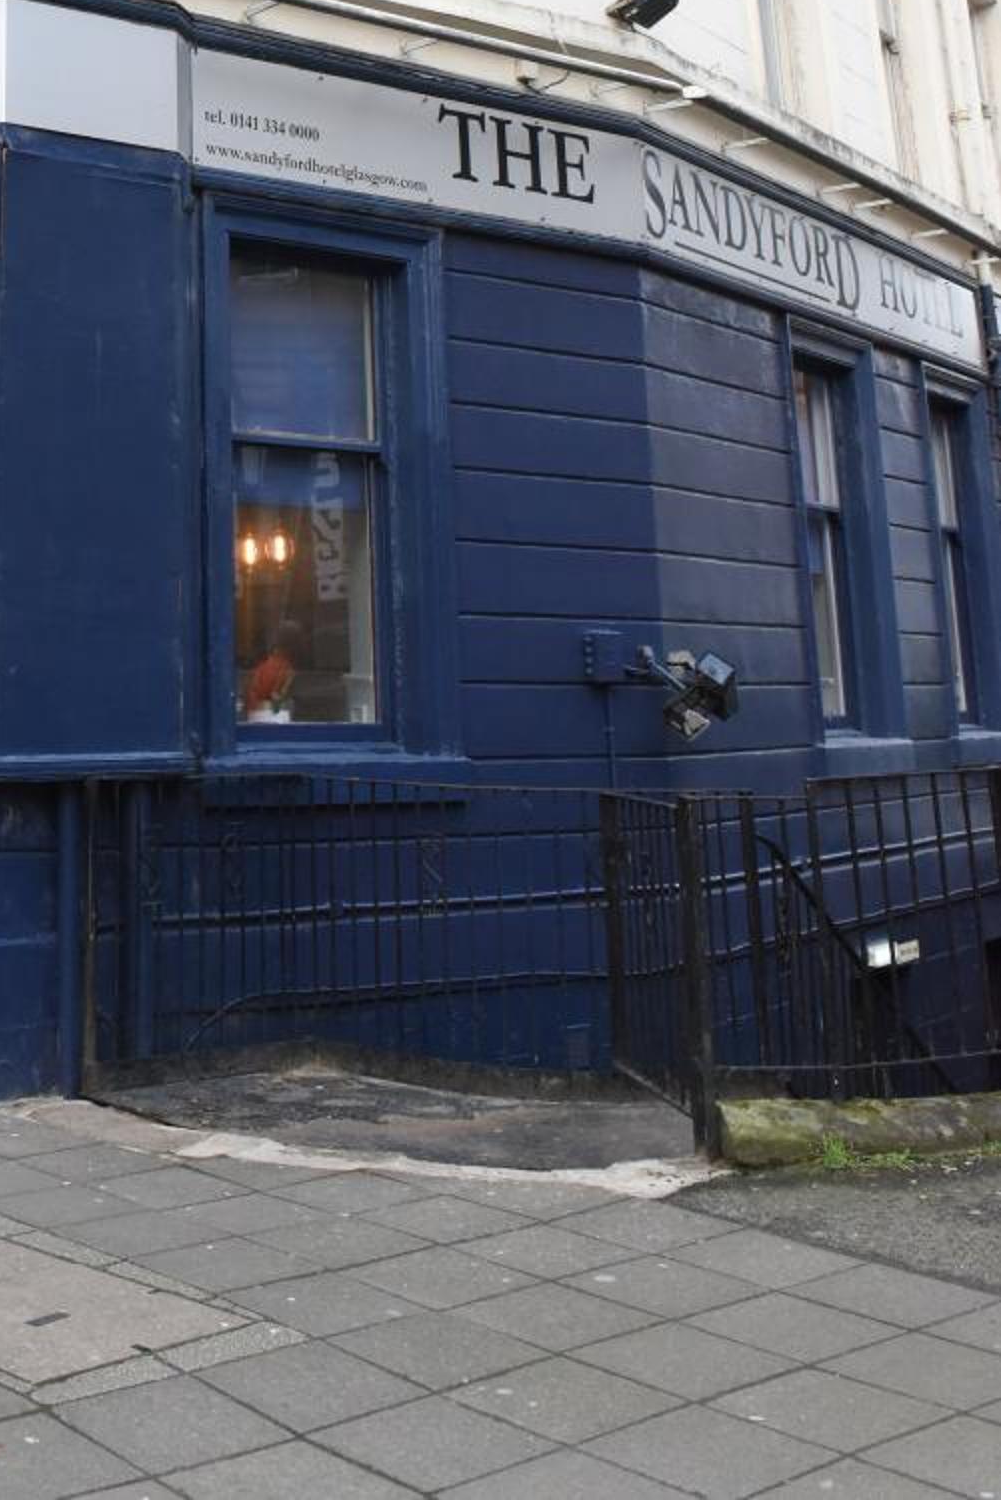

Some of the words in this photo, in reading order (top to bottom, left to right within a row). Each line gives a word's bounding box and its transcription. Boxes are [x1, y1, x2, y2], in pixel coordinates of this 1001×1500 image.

[204, 110, 226, 126] tel.
[230, 112, 259, 132] 0141
[262, 118, 286, 135] 334
[289, 123, 320, 142] 0000
[206, 143, 428, 193] www.sandyfordhotelglasgow.com
[438, 103, 596, 205] THE
[640, 148, 861, 313] SANDYFORD
